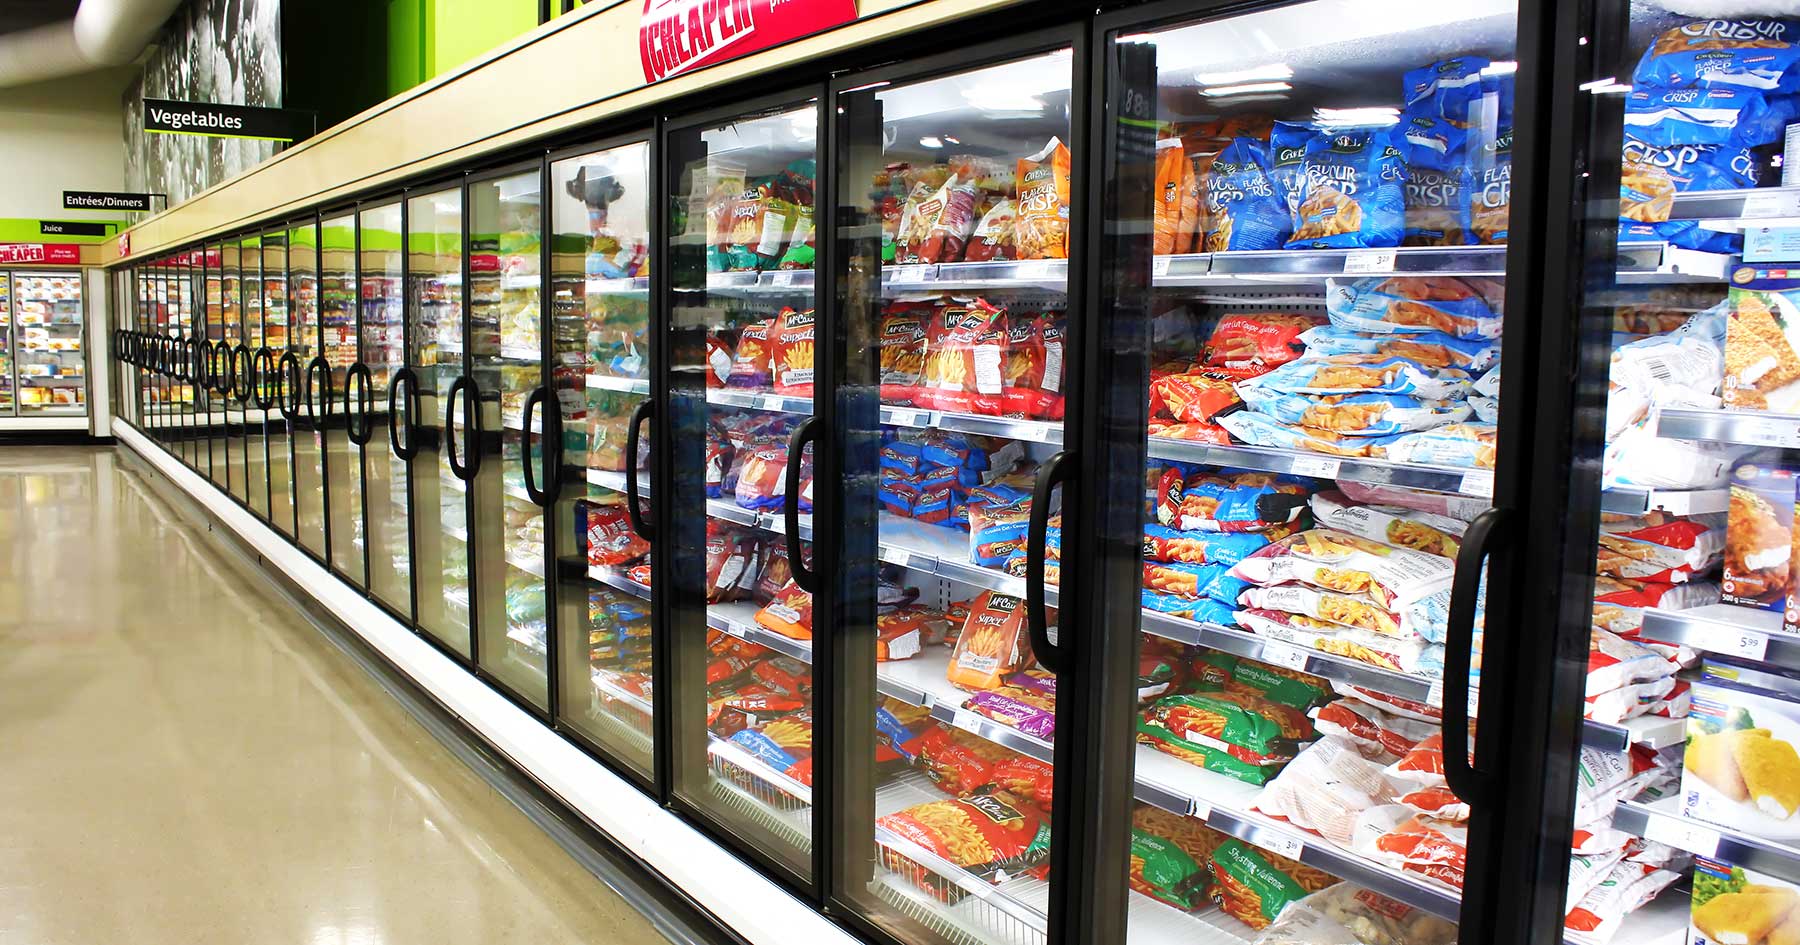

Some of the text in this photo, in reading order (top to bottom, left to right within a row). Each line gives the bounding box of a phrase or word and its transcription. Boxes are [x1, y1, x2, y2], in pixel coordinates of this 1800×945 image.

[648, 0, 752, 79] CHEAPER
[1663, 92, 1698, 103] CRISP
[150, 108, 242, 129] Vegetables
[1020, 184, 1055, 201] FLAVOUR
[1406, 184, 1457, 207] RISP
[66, 195, 143, 208] Entrées/Dinners
[1723, 568, 1732, 580] 6
